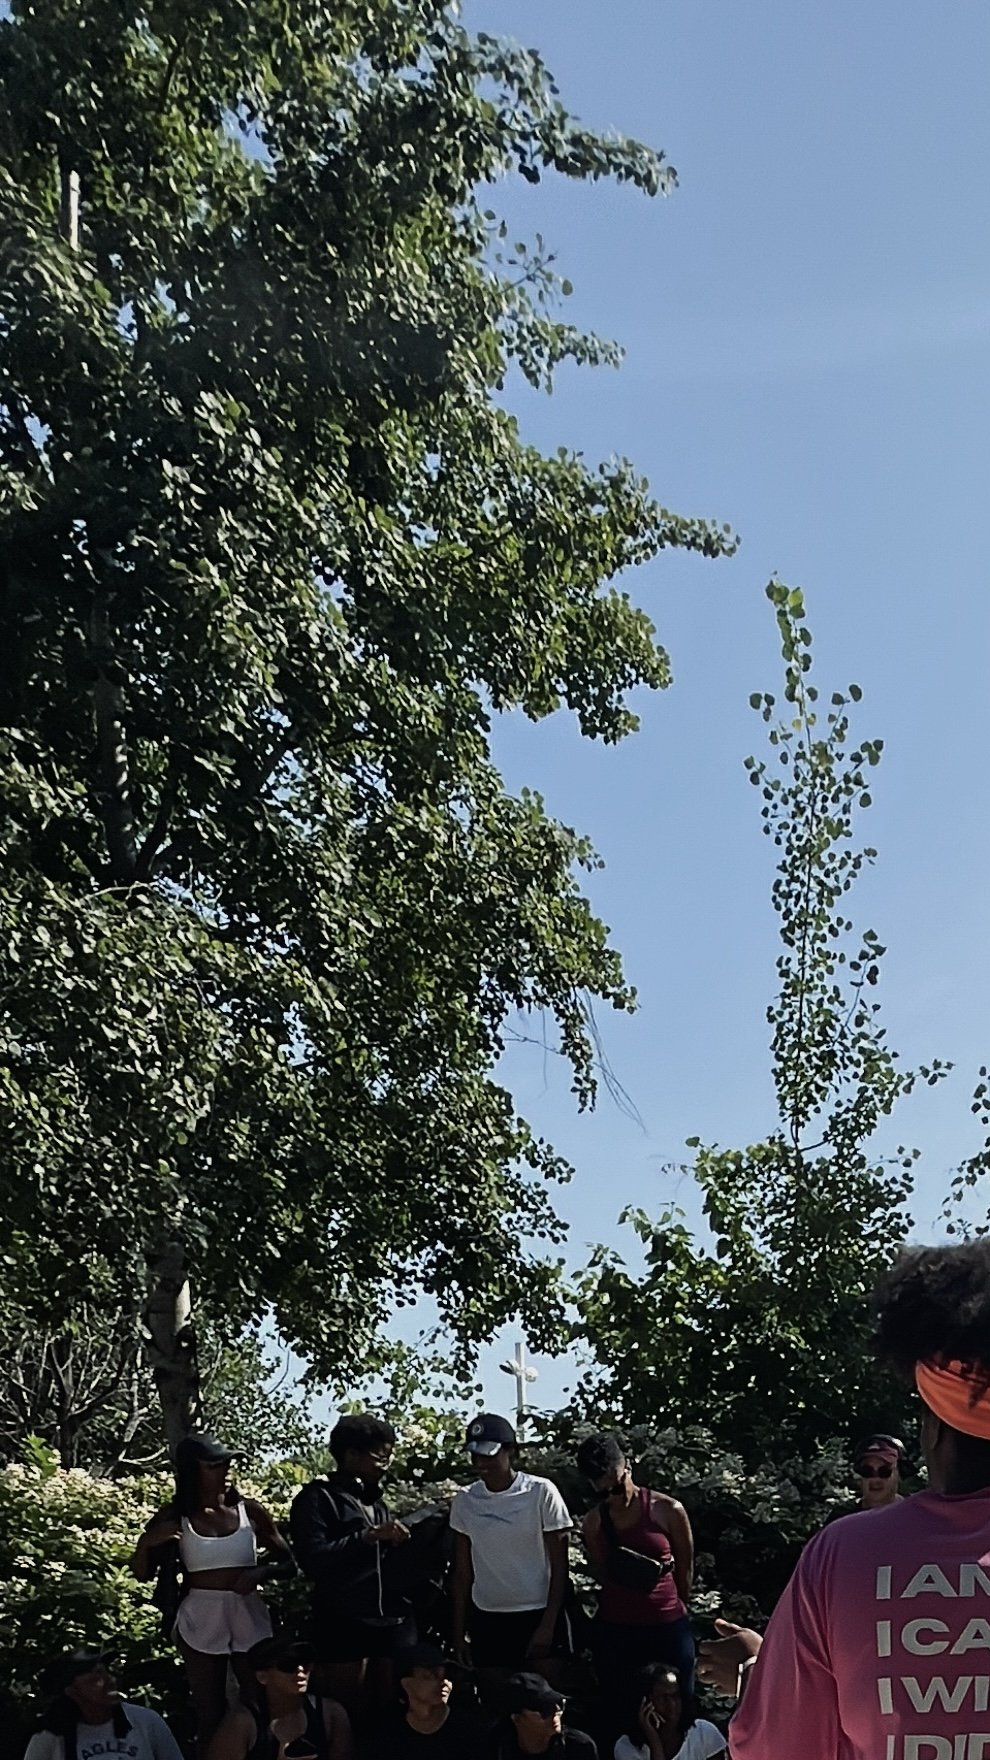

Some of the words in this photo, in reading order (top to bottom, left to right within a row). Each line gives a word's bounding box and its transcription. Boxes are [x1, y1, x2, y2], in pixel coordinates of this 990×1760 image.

[876, 1565, 892, 1600] I
[876, 1620, 891, 1657] I
[877, 1677, 894, 1715] I
